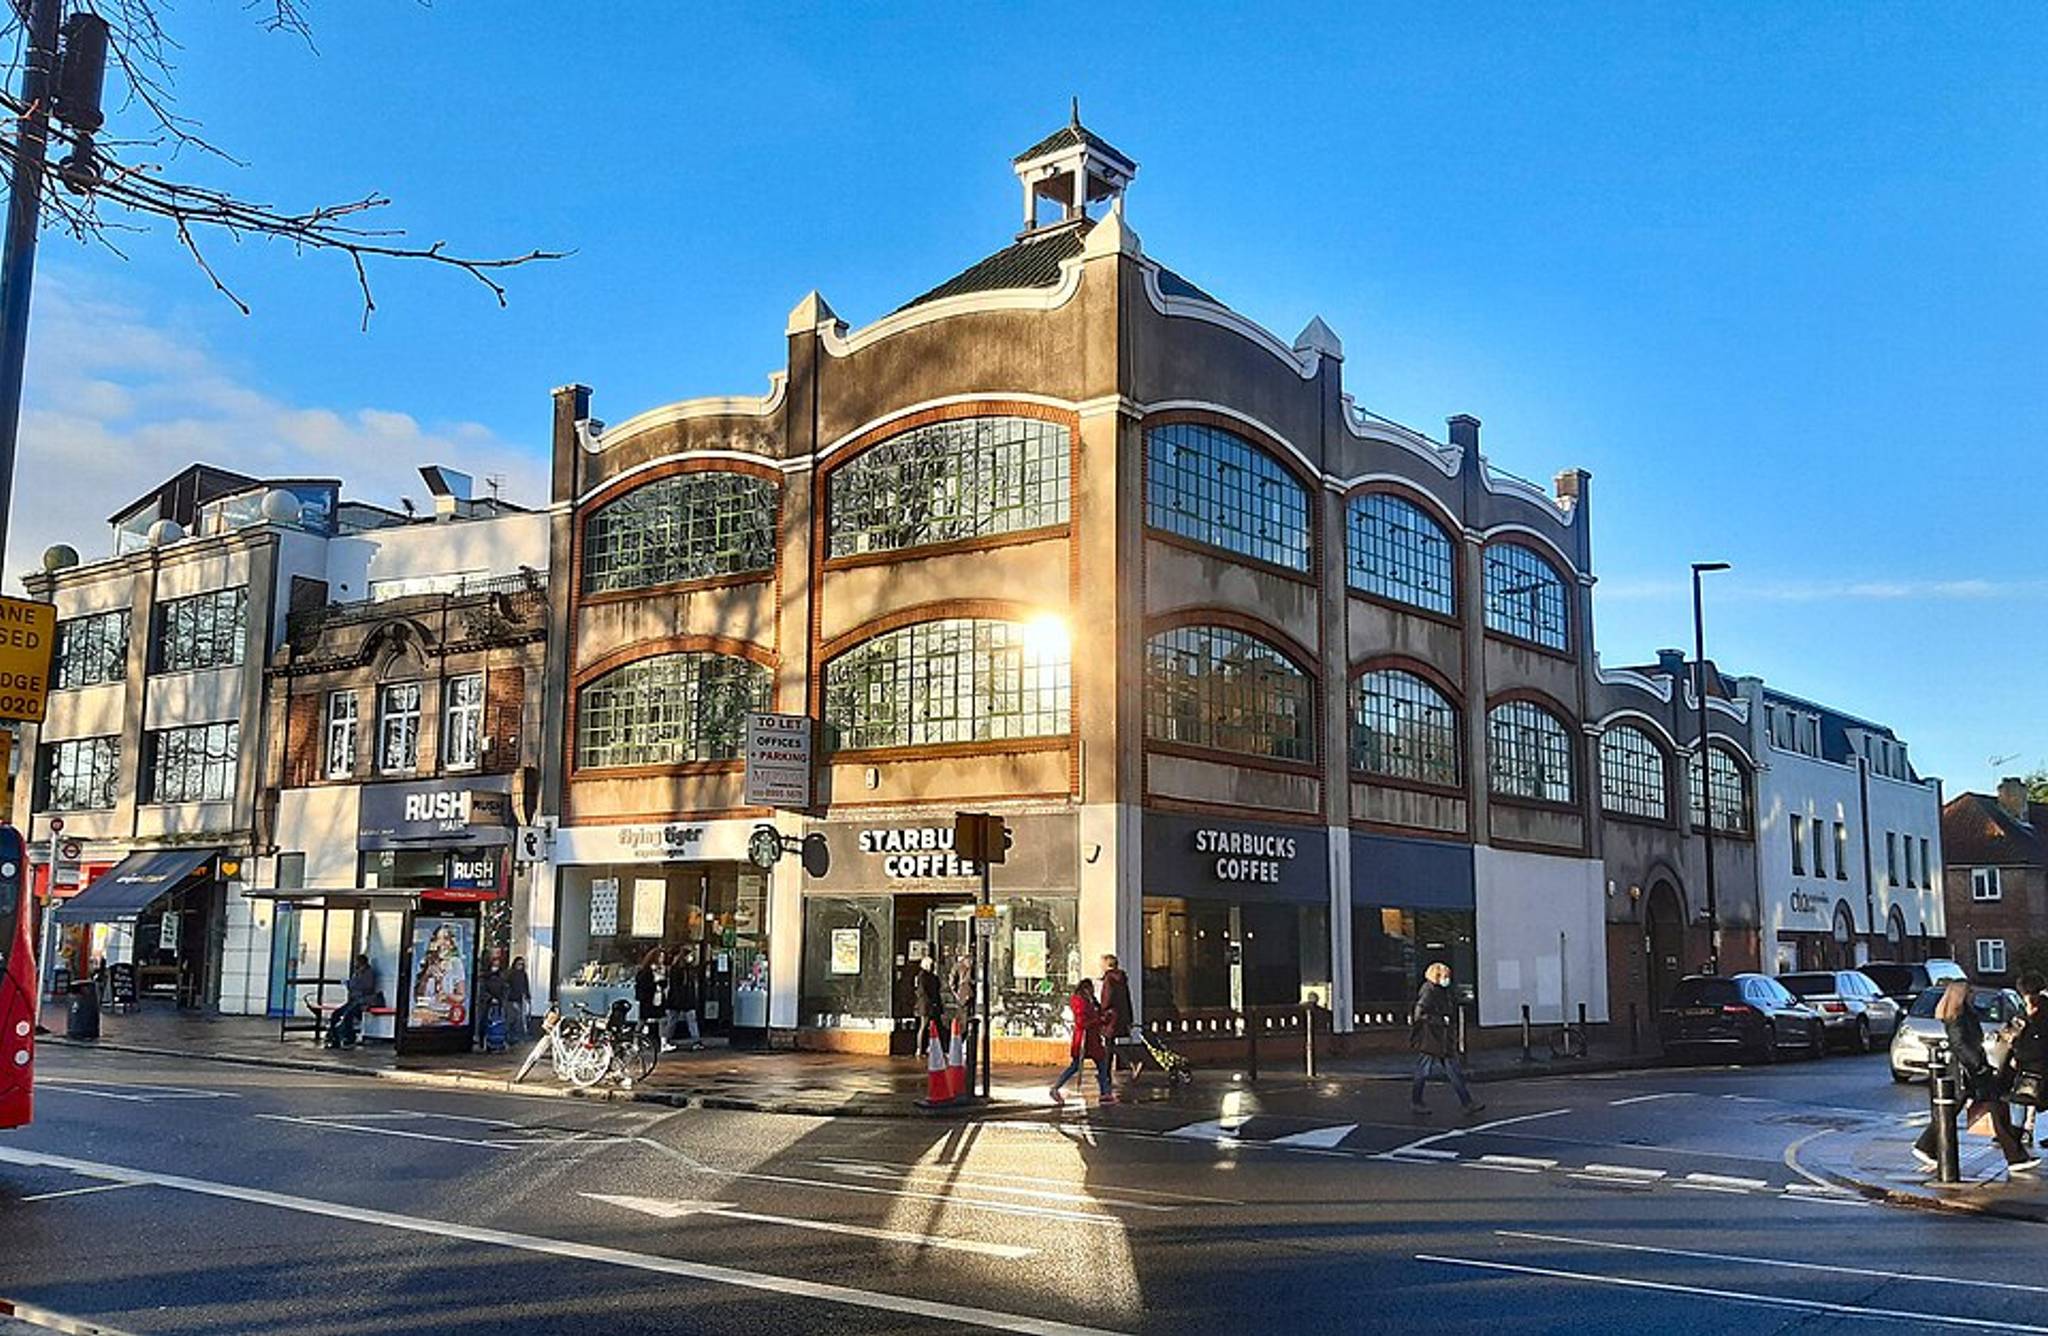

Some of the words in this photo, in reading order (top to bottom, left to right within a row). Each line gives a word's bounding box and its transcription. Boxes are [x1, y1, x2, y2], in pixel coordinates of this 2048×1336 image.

[0, 627, 40, 649] SED
[0, 672, 41, 693] DGE
[0, 695, 39, 714] 020
[757, 717, 775, 727] TO
[780, 719, 801, 729] LET
[756, 736, 802, 748] OFFICES
[760, 751, 807, 763] PARKING
[405, 792, 466, 821] RUSH
[618, 828, 662, 848] flying
[664, 826, 703, 846] tiger
[858, 827, 1013, 851] STARBU
[1195, 829, 1296, 859] STARBUCKS
[453, 861, 494, 879] RUSH
[884, 855, 974, 877] COFFEE
[1216, 857, 1279, 882] COFFEE
